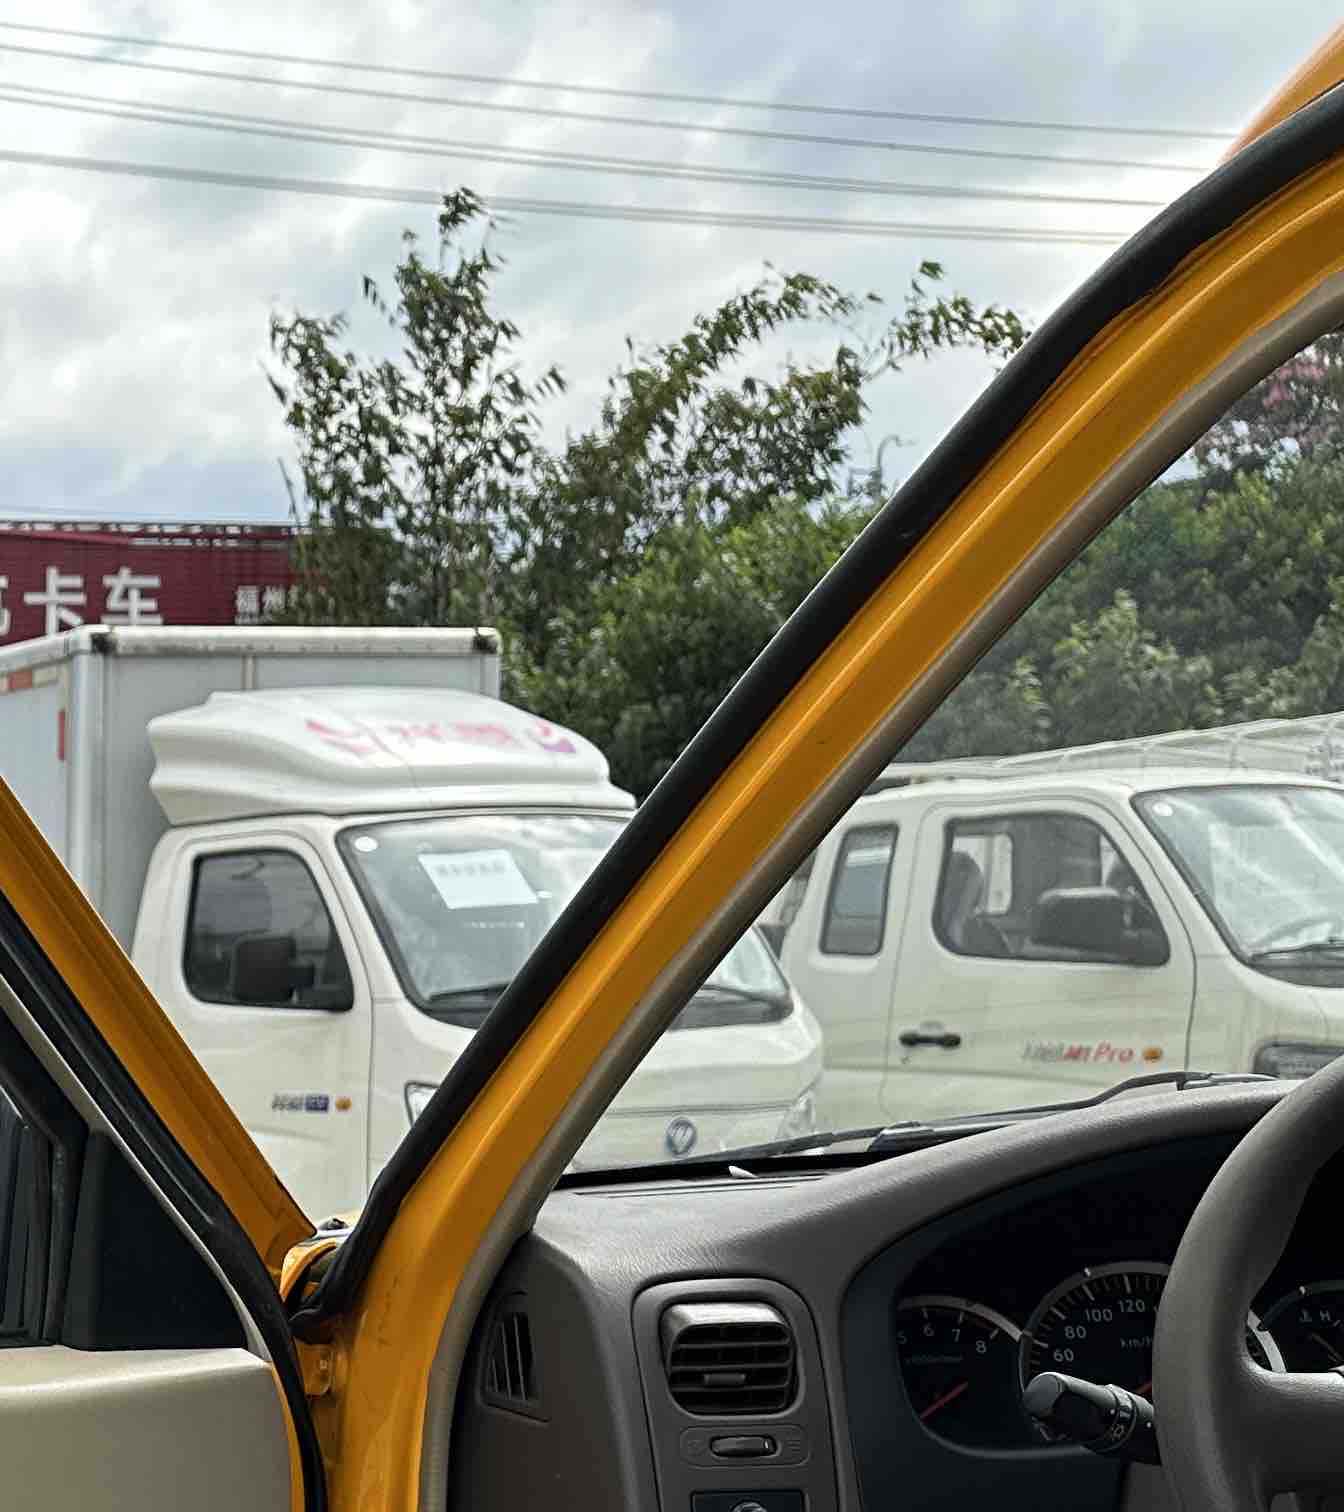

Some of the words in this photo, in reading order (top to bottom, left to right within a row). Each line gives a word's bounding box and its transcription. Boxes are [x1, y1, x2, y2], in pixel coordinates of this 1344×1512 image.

[1118, 1298, 1146, 1313] 120
[1083, 1308, 1113, 1323] 100
[923, 1322, 936, 1337] 6
[951, 1328, 961, 1343] 7
[1064, 1325, 1088, 1340] 80
[976, 1338, 988, 1354] 8
[1053, 1347, 1075, 1362] 60
